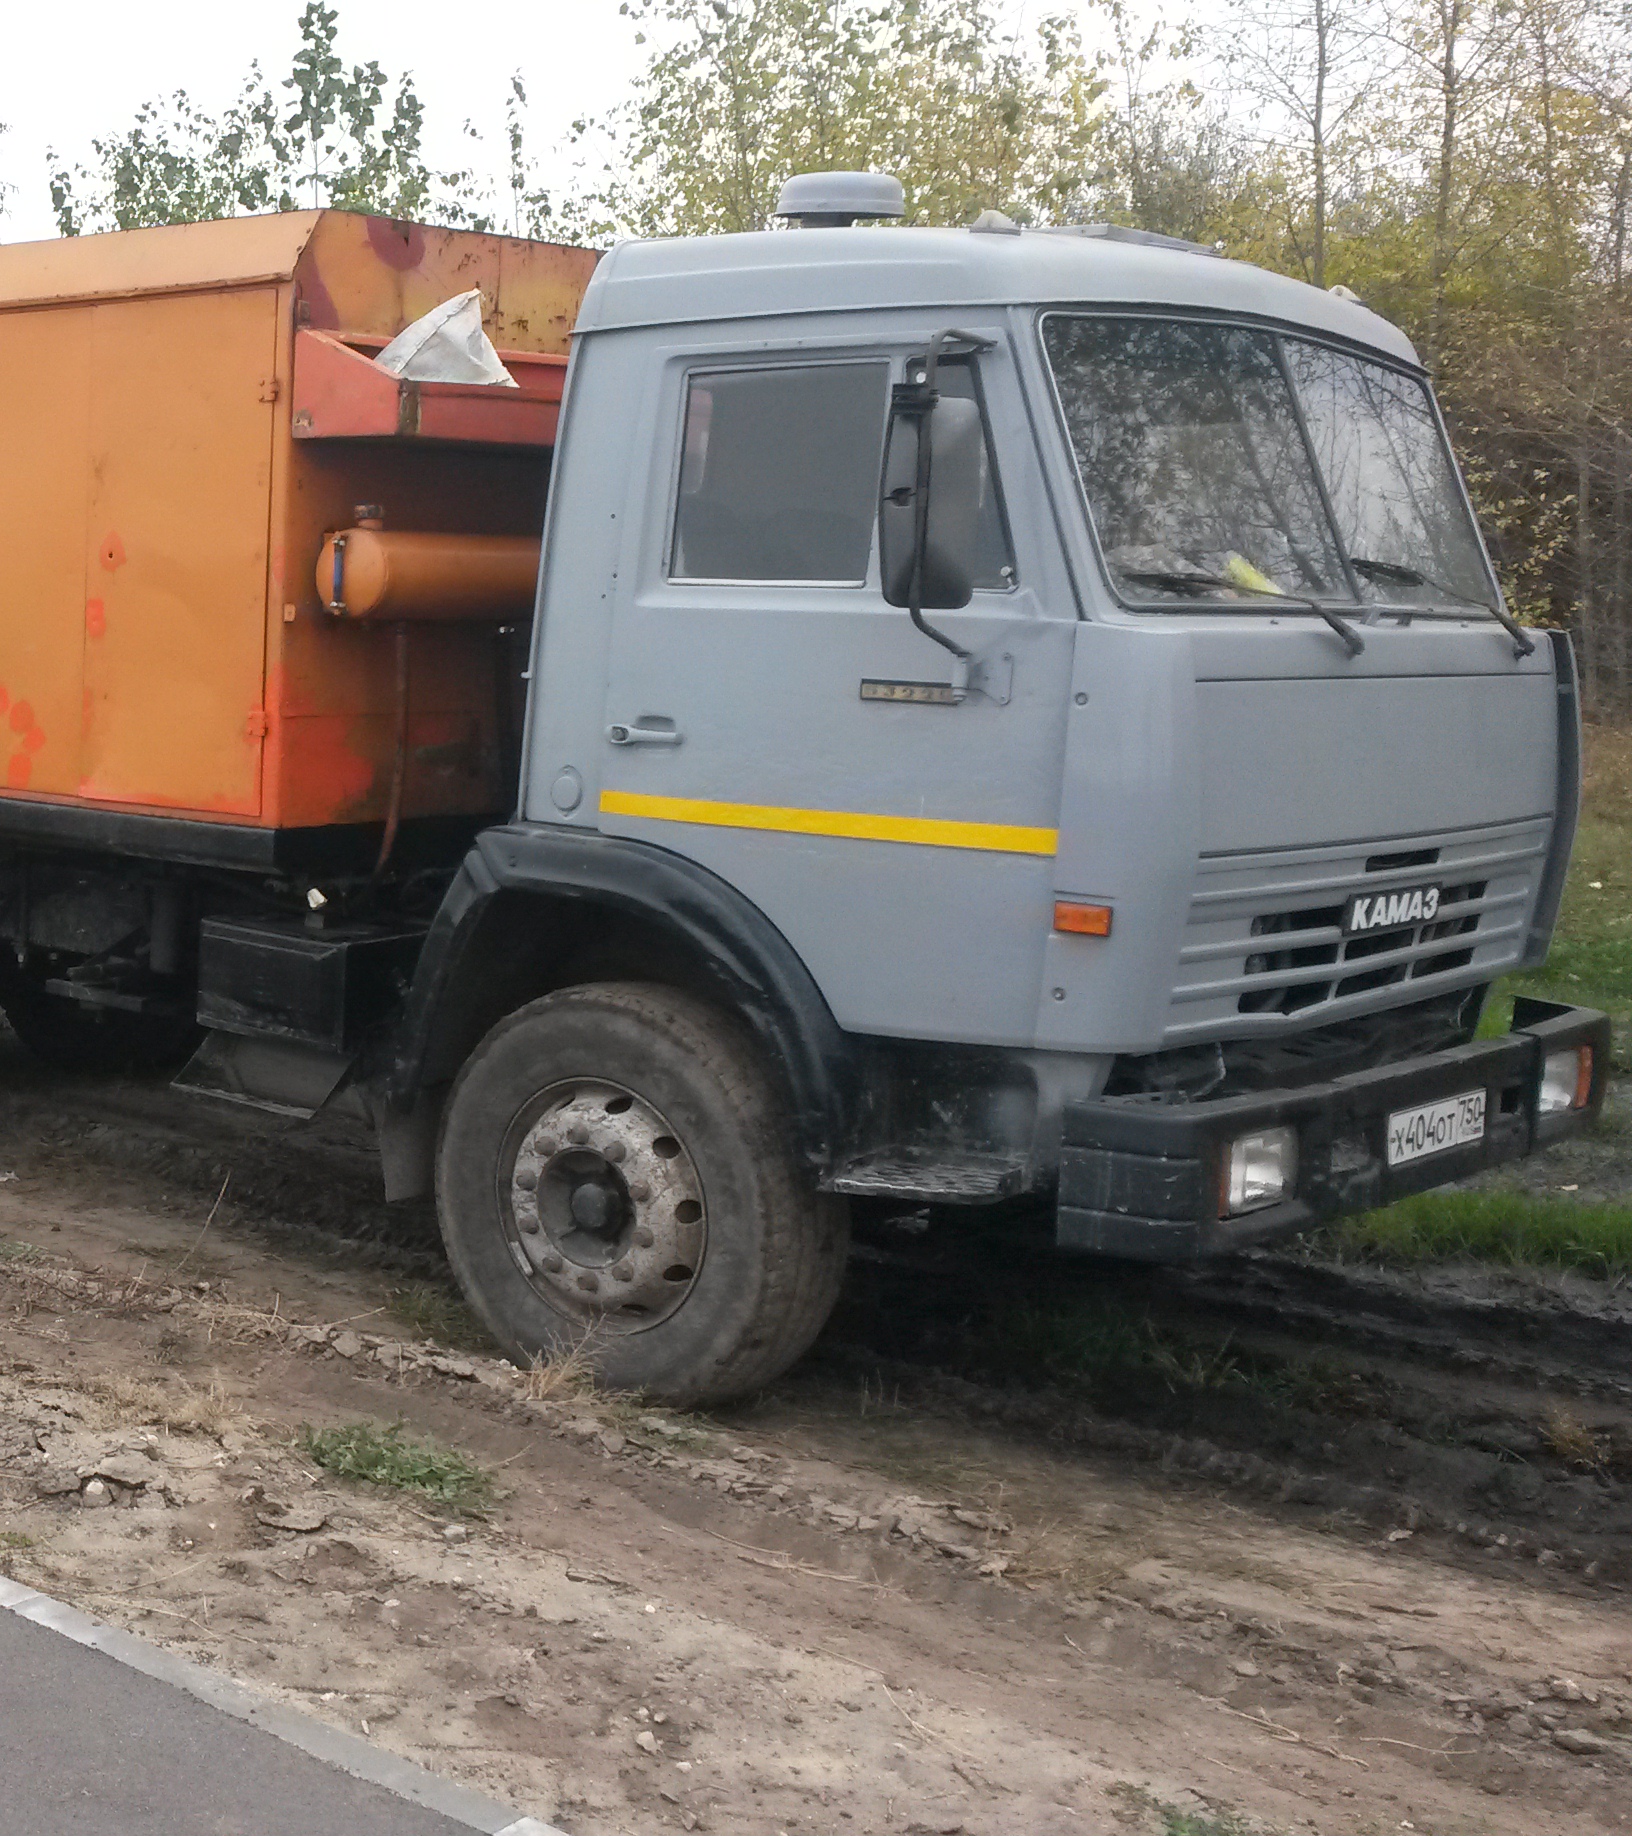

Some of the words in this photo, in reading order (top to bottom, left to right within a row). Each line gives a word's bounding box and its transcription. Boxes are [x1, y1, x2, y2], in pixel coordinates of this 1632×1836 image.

[1350, 887, 1440, 931] КАМАЗ
[1394, 1110, 1456, 1158] Х404ОТ
[1459, 1096, 1482, 1127] 750
